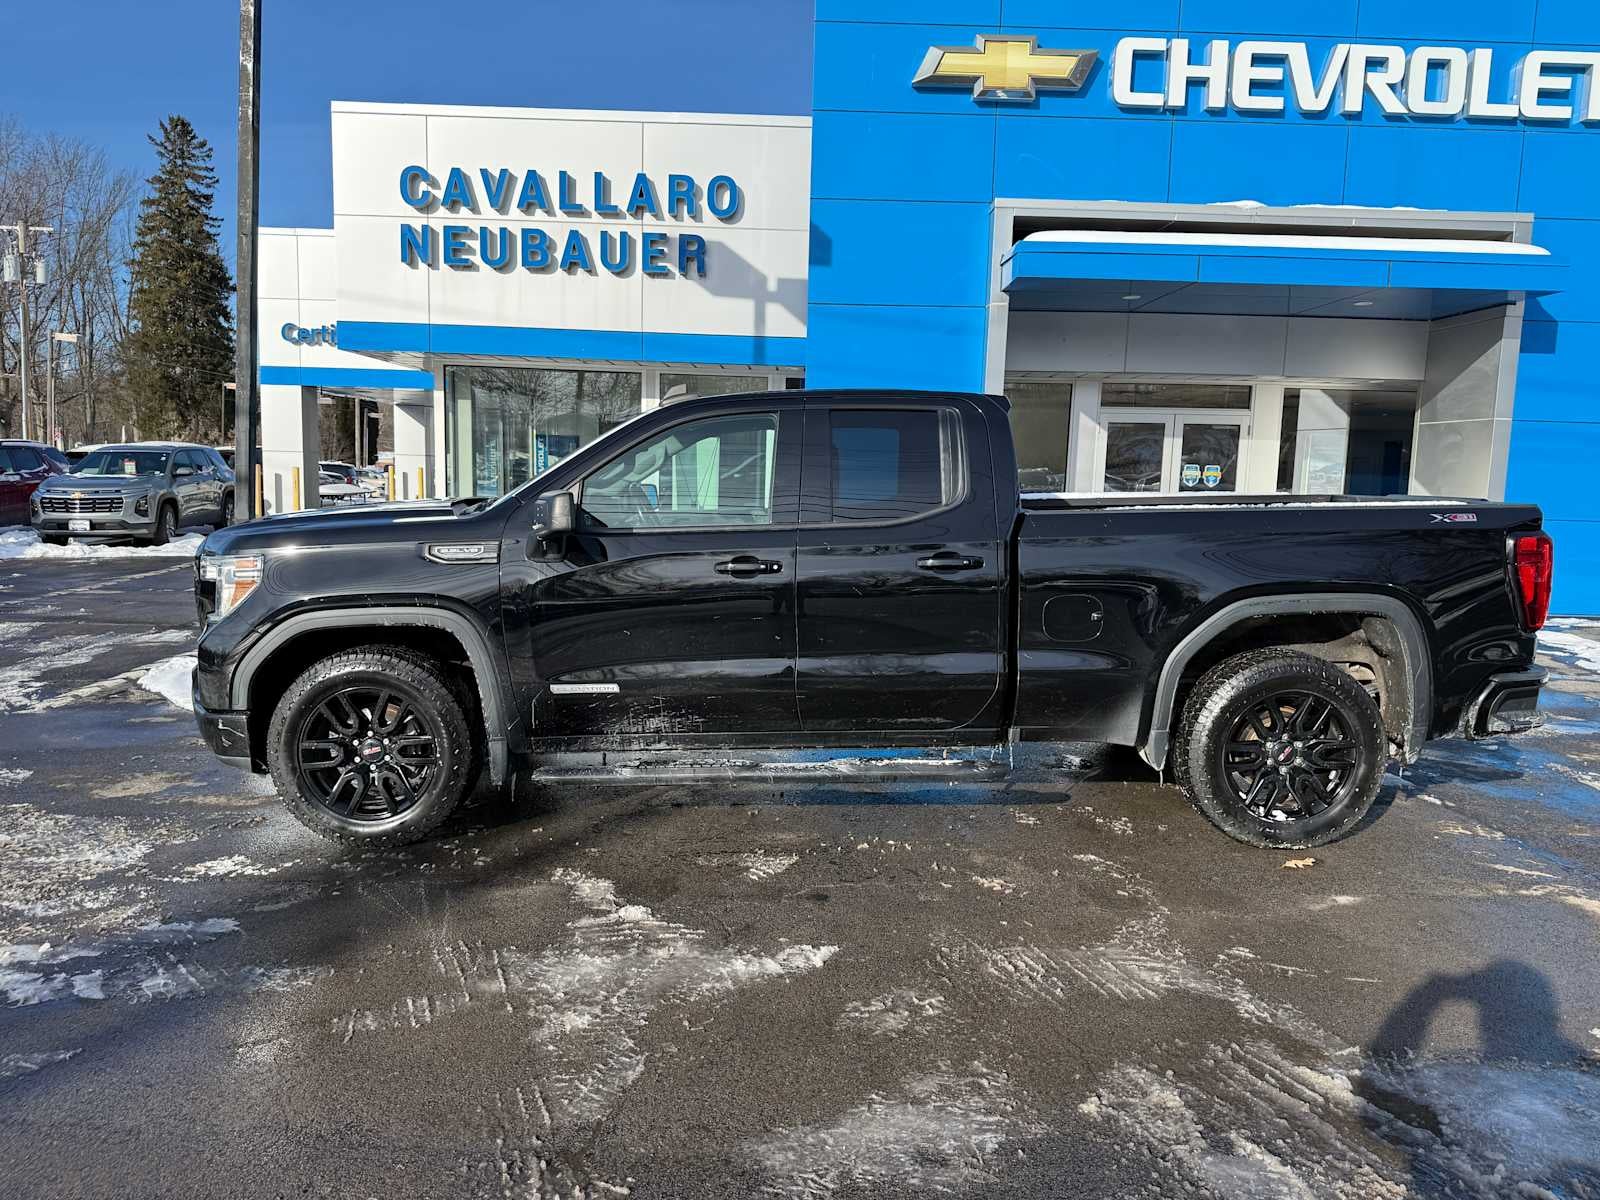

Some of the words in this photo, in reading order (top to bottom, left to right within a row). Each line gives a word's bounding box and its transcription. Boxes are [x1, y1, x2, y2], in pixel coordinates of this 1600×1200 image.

[1113, 36, 1600, 120] CHEVROLET
[400, 165, 741, 220] CAVALLARO
[400, 223, 708, 276] NEUBAUER
[281, 322, 336, 345] Certi
